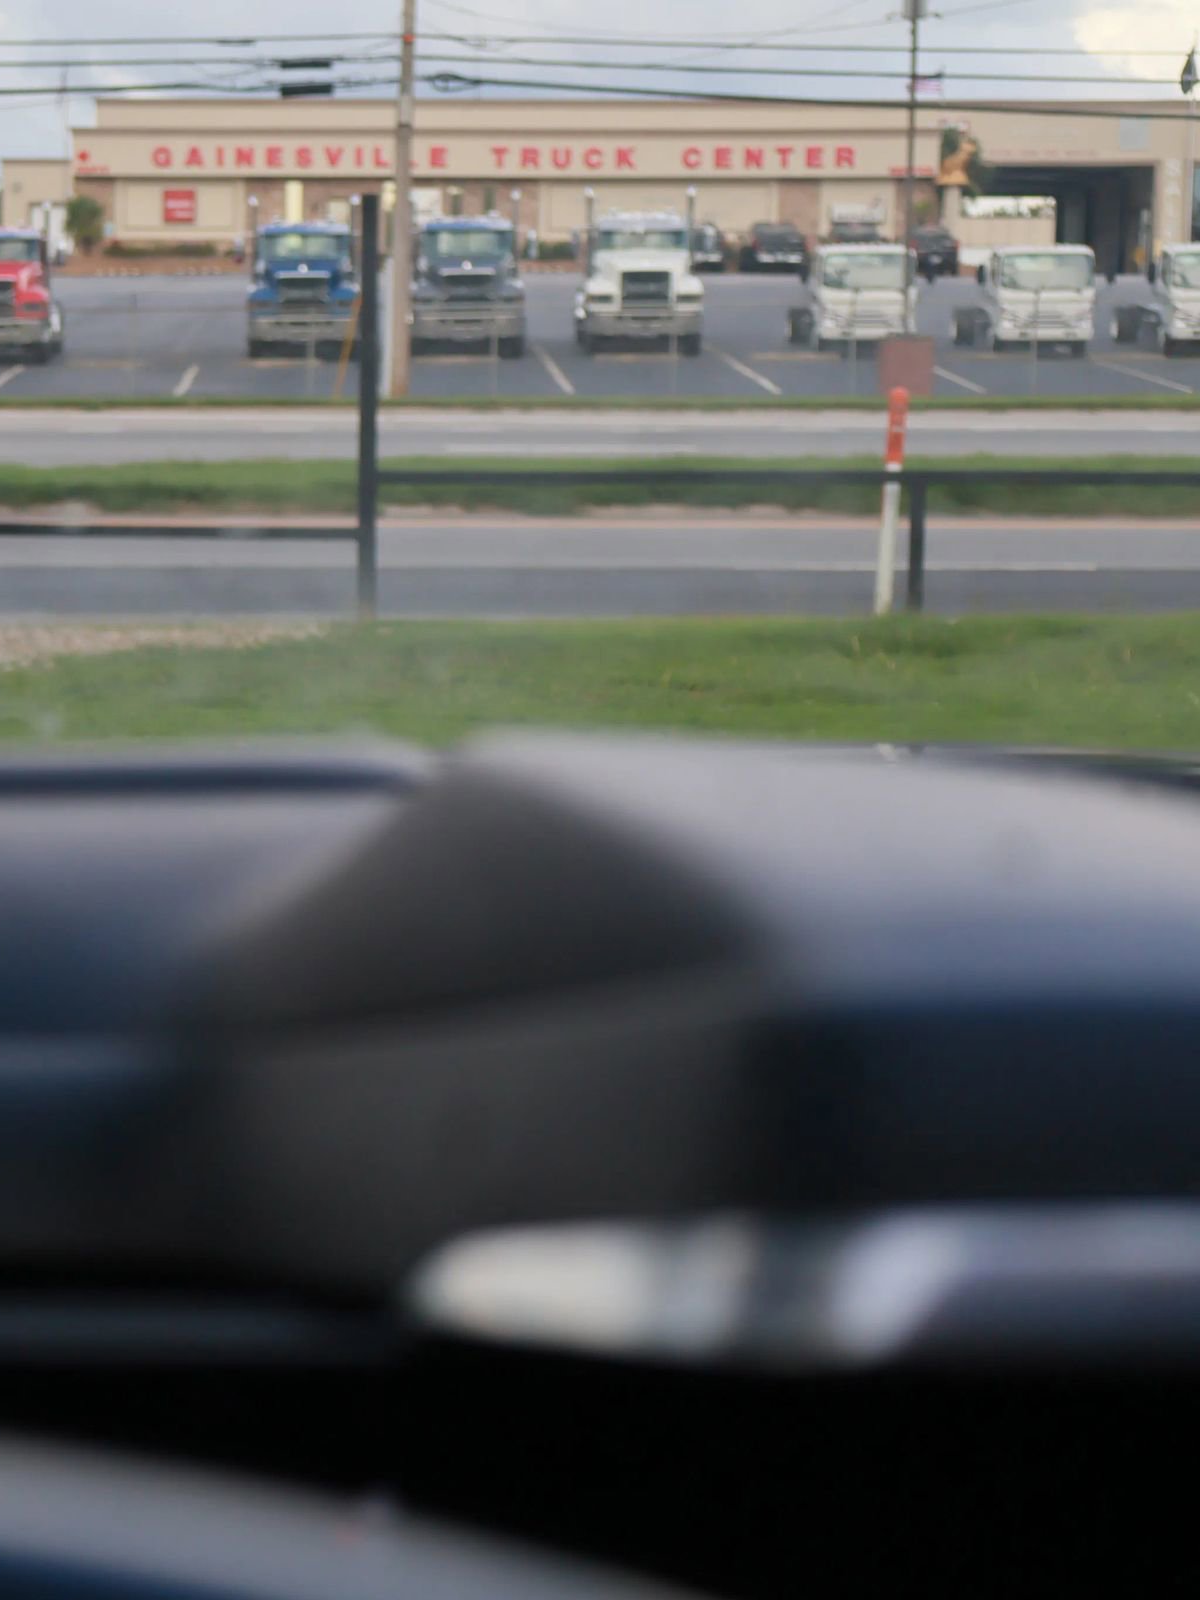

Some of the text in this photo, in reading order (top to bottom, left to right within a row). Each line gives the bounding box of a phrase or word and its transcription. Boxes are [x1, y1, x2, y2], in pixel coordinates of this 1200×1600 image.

[151, 145, 857, 170] GAINESVILE TRUCK CENTER
